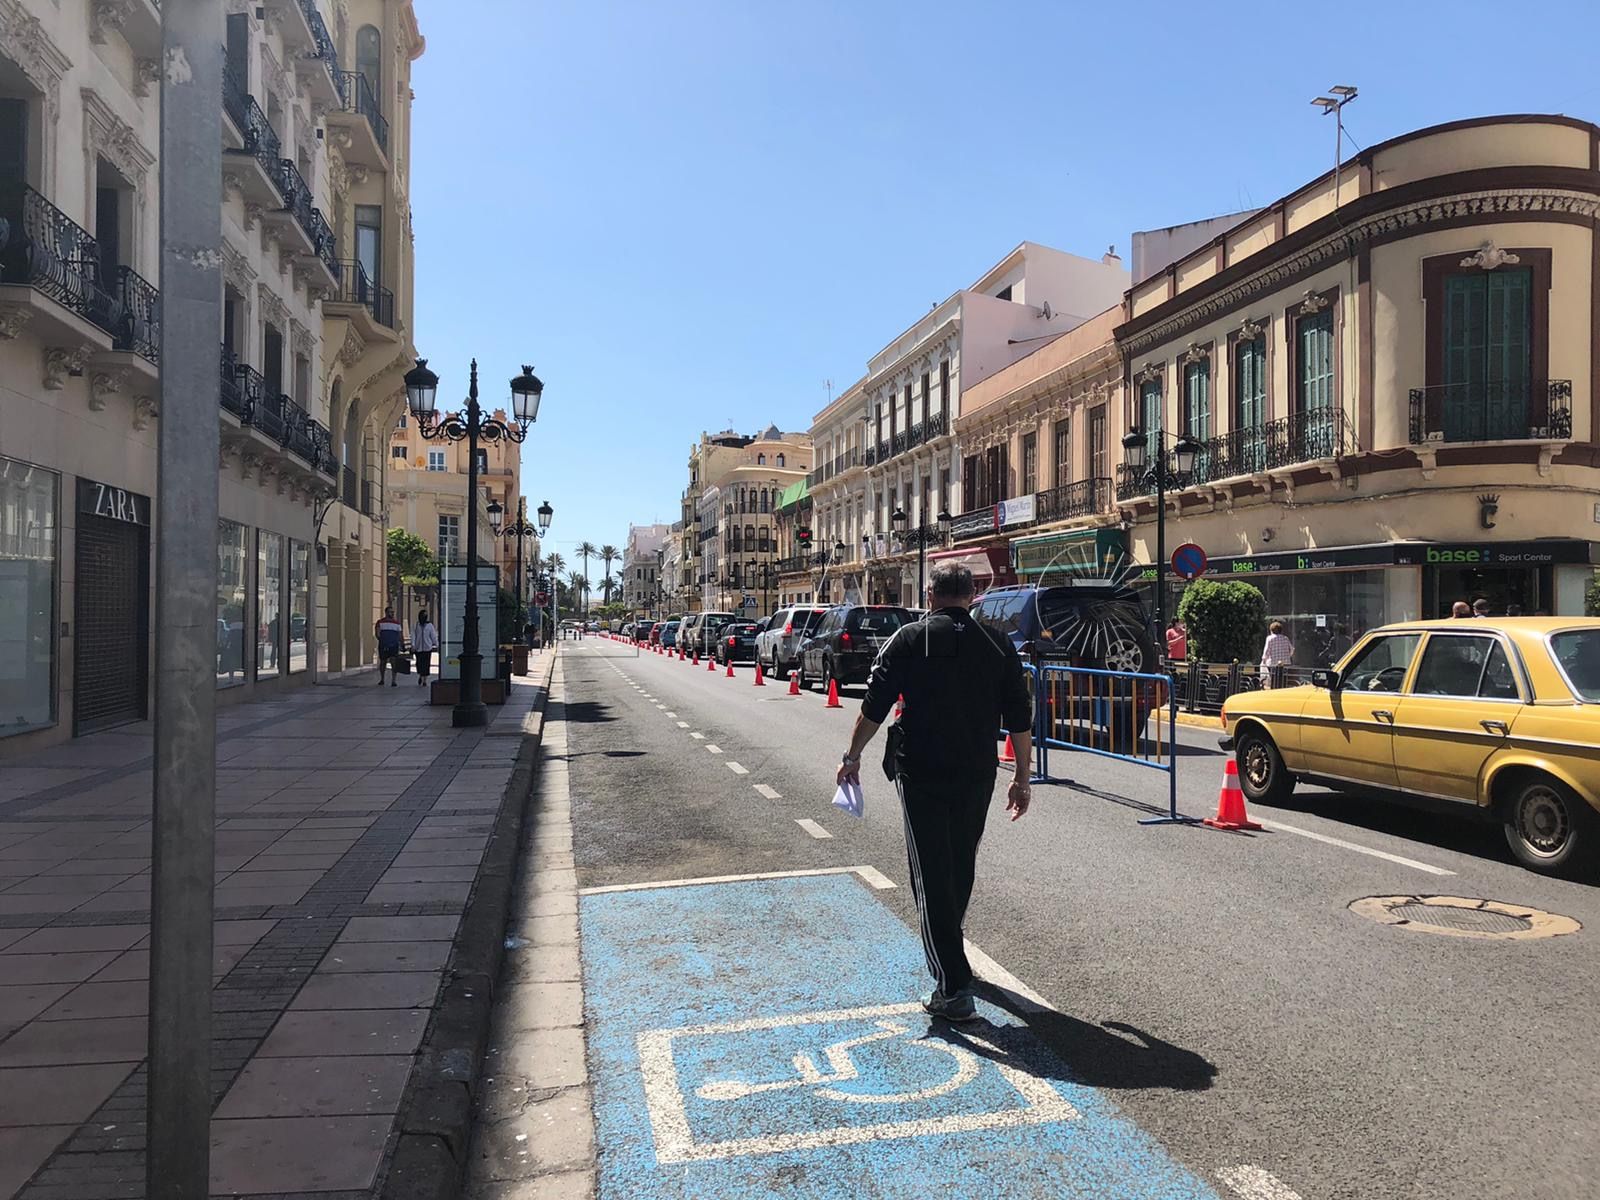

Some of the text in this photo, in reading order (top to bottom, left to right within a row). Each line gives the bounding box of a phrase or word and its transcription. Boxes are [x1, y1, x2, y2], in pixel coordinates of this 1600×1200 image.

[95, 483, 137, 524] ZARA
[1499, 553, 1521, 563] Sport
[1523, 553, 1552, 561] Center
